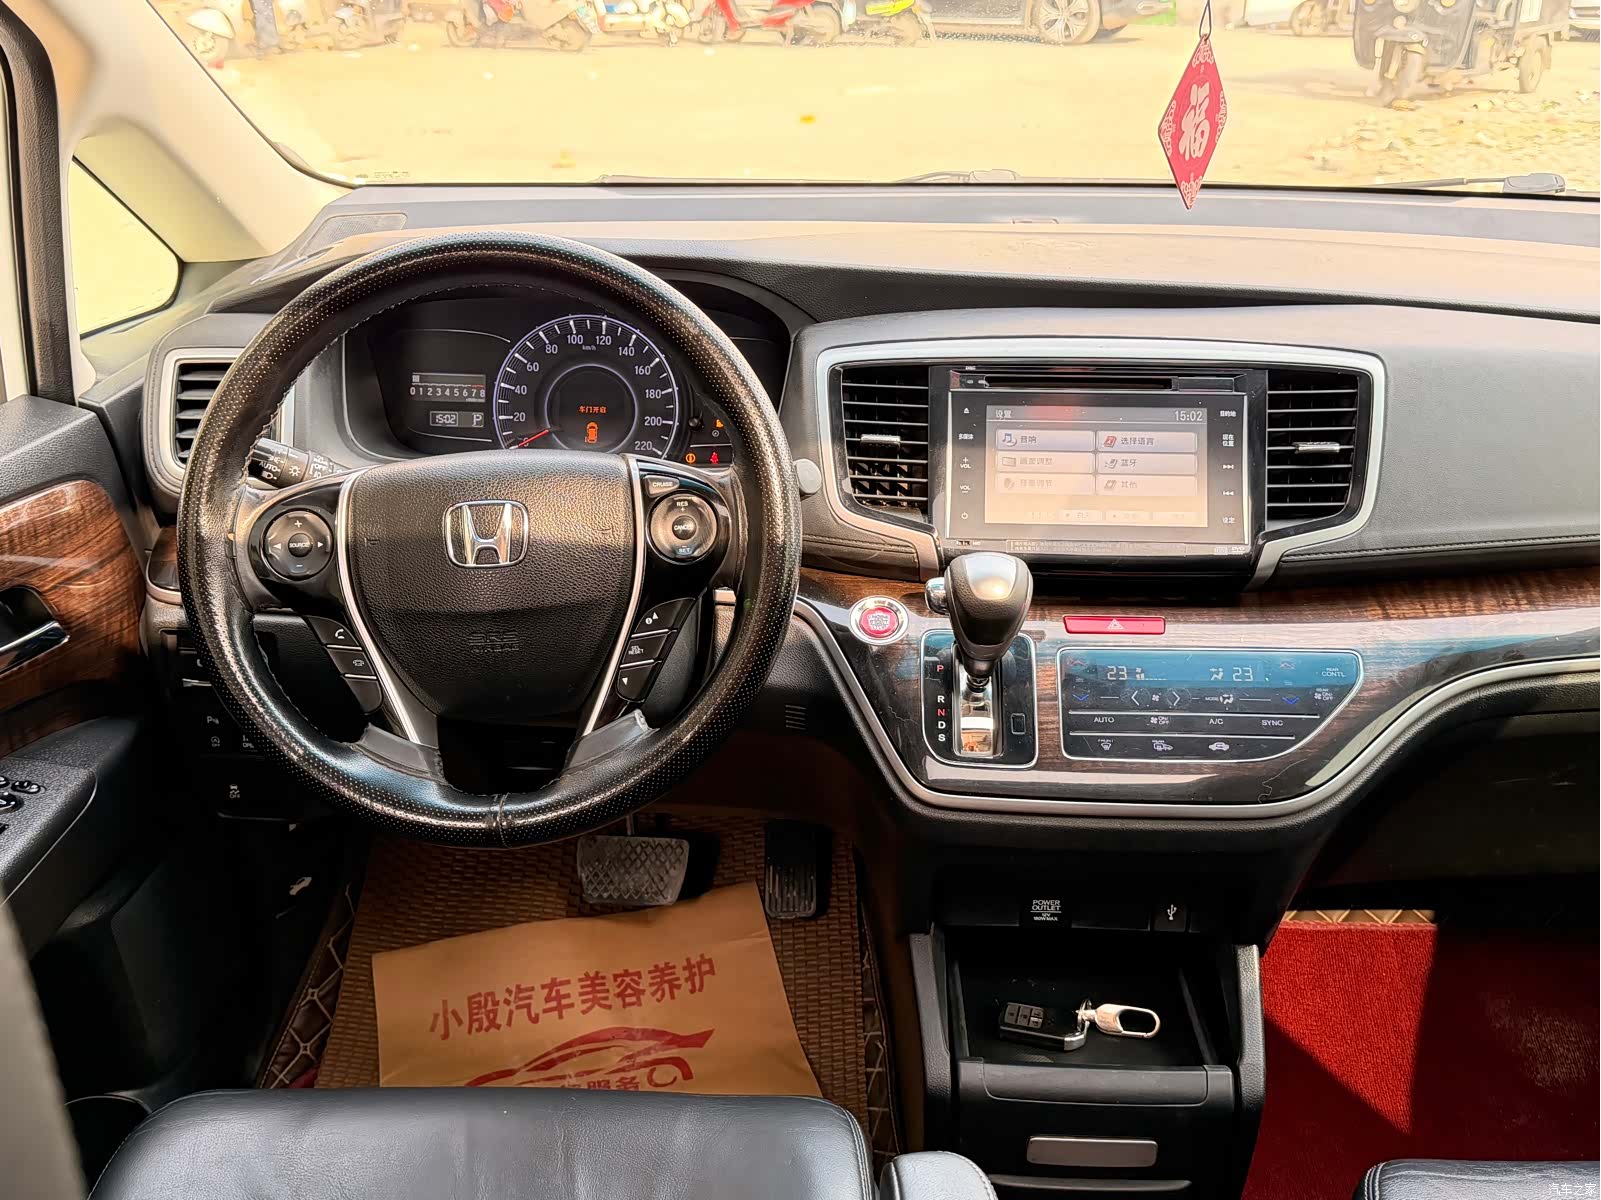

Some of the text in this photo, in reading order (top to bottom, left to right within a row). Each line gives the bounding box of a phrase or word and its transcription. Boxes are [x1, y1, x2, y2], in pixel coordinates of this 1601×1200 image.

[567, 334, 584, 345] 100
[595, 335, 612, 346] 120
[545, 344, 558, 355] 80
[618, 346, 635, 357] 140
[526, 361, 540, 372] 60
[634, 365, 651, 376] 160
[409, 386, 486, 398] 0 1 2 3 4 5 6 7 8
[514, 385, 528, 395] 40
[645, 388, 662, 399] 180
[578, 405, 607, 414] 车门开启
[513, 412, 526, 422] 20
[644, 416, 663, 427] 200
[1174, 410, 1203, 422] 15:02
[1020, 435, 1037, 444] 音响
[1120, 437, 1155, 446] 选择语言
[634, 440, 653, 451] 220
[936, 664, 945, 673] P
[1107, 665, 1128, 680] 23
[1232, 666, 1254, 682] 23
[937, 695, 945, 703] R
[937, 708, 945, 717] N
[937, 721, 946, 729] D
[937, 733, 946, 742] S
[429, 953, 716, 1041] 小殷汽车美容养护
